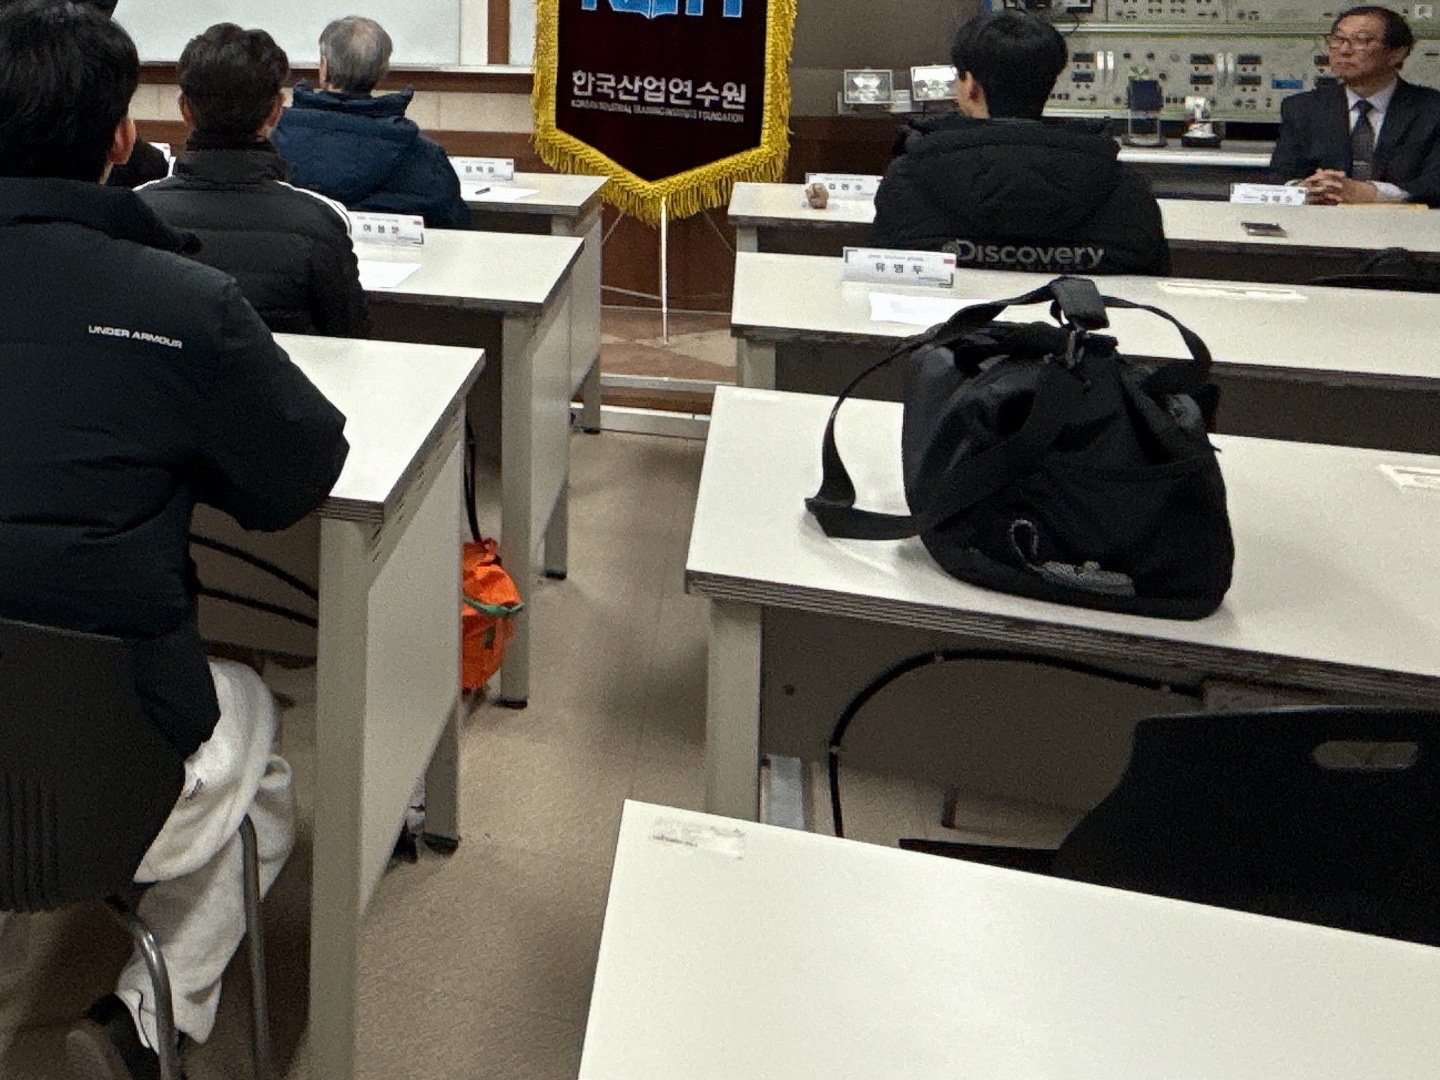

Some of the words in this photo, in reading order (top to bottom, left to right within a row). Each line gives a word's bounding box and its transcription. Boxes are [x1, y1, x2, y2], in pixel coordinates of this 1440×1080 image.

[572, 69, 747, 111] 한국산업연수원
[88, 324, 130, 338] UNDER
[131, 331, 183, 349] ARMOUR
